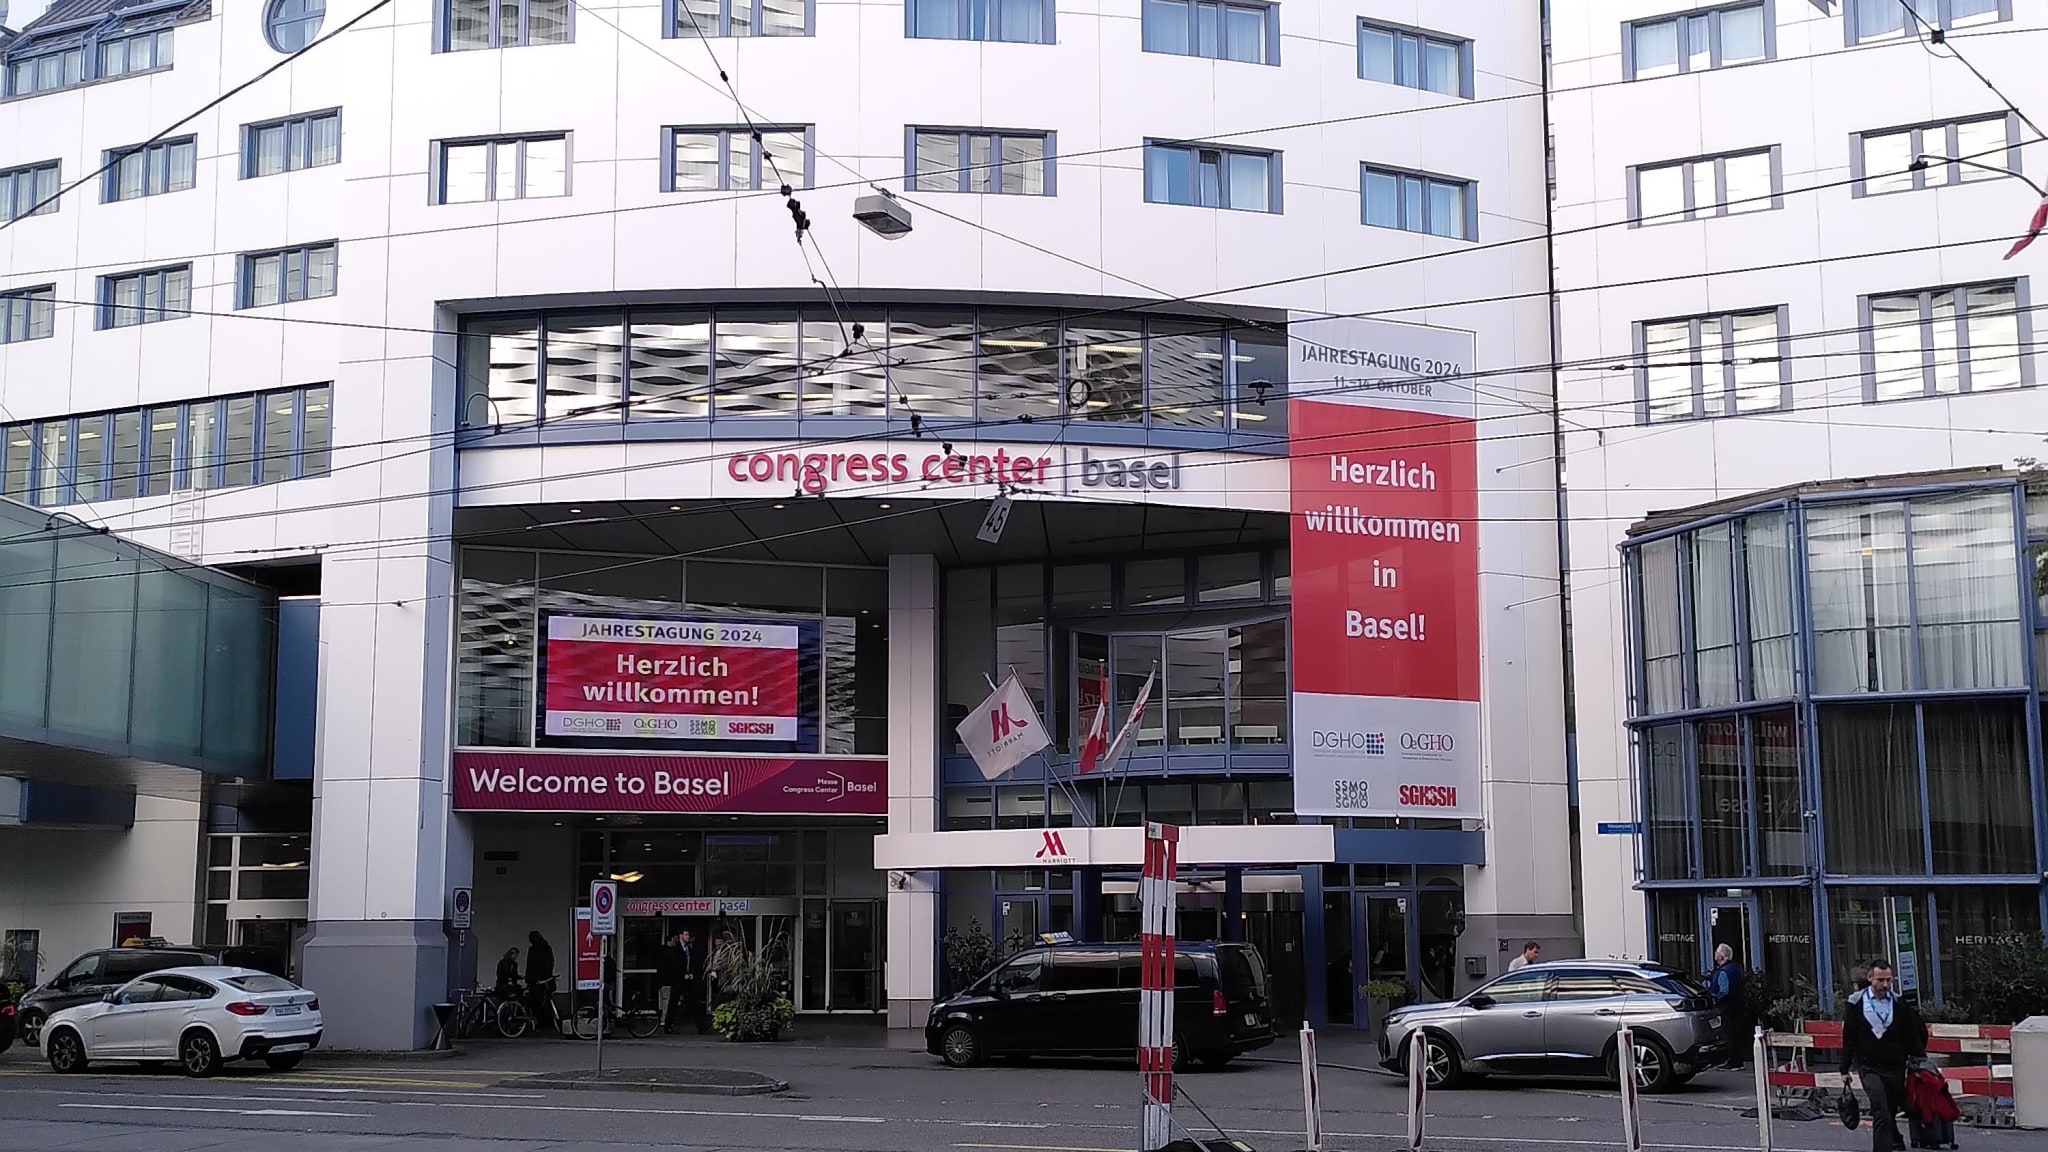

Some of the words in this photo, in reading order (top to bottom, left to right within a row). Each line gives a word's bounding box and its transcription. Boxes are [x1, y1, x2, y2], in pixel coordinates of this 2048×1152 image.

[1302, 344, 1421, 373] JAHRESTAGUNG
[1425, 359, 1462, 379] 2024
[728, 452, 909, 493] congress
[921, 447, 1052, 485] center
[1082, 447, 1181, 490] basel
[1330, 455, 1436, 490] Herzlich
[985, 504, 1008, 533] 45
[1305, 505, 1460, 543] willkommen
[1373, 559, 1397, 588] in
[582, 623, 715, 641] JAHRESTAGUNG
[720, 629, 763, 643] 2024
[1346, 610, 1426, 641] Basel!
[617, 654, 728, 677] Herzlich
[583, 681, 759, 706] willkommen!
[562, 717, 605, 728] DGHO
[1312, 731, 1365, 749] DGHO
[1400, 732, 1454, 751] OeGHO
[469, 768, 608, 794] Welcome
[615, 772, 645, 794] to
[654, 771, 729, 795] Basel
[782, 785, 814, 794] Congress
[847, 781, 877, 792] Basel
[1335, 780, 1368, 791] SSMO
[1335, 790, 1368, 800] SSOM
[1336, 799, 1369, 809] SGMO
[625, 901, 669, 914] congress
[672, 899, 711, 911] center
[720, 898, 749, 911] basel
[1659, 934, 1695, 942] HERITAGE
[1769, 934, 1811, 943] HERITAGE
